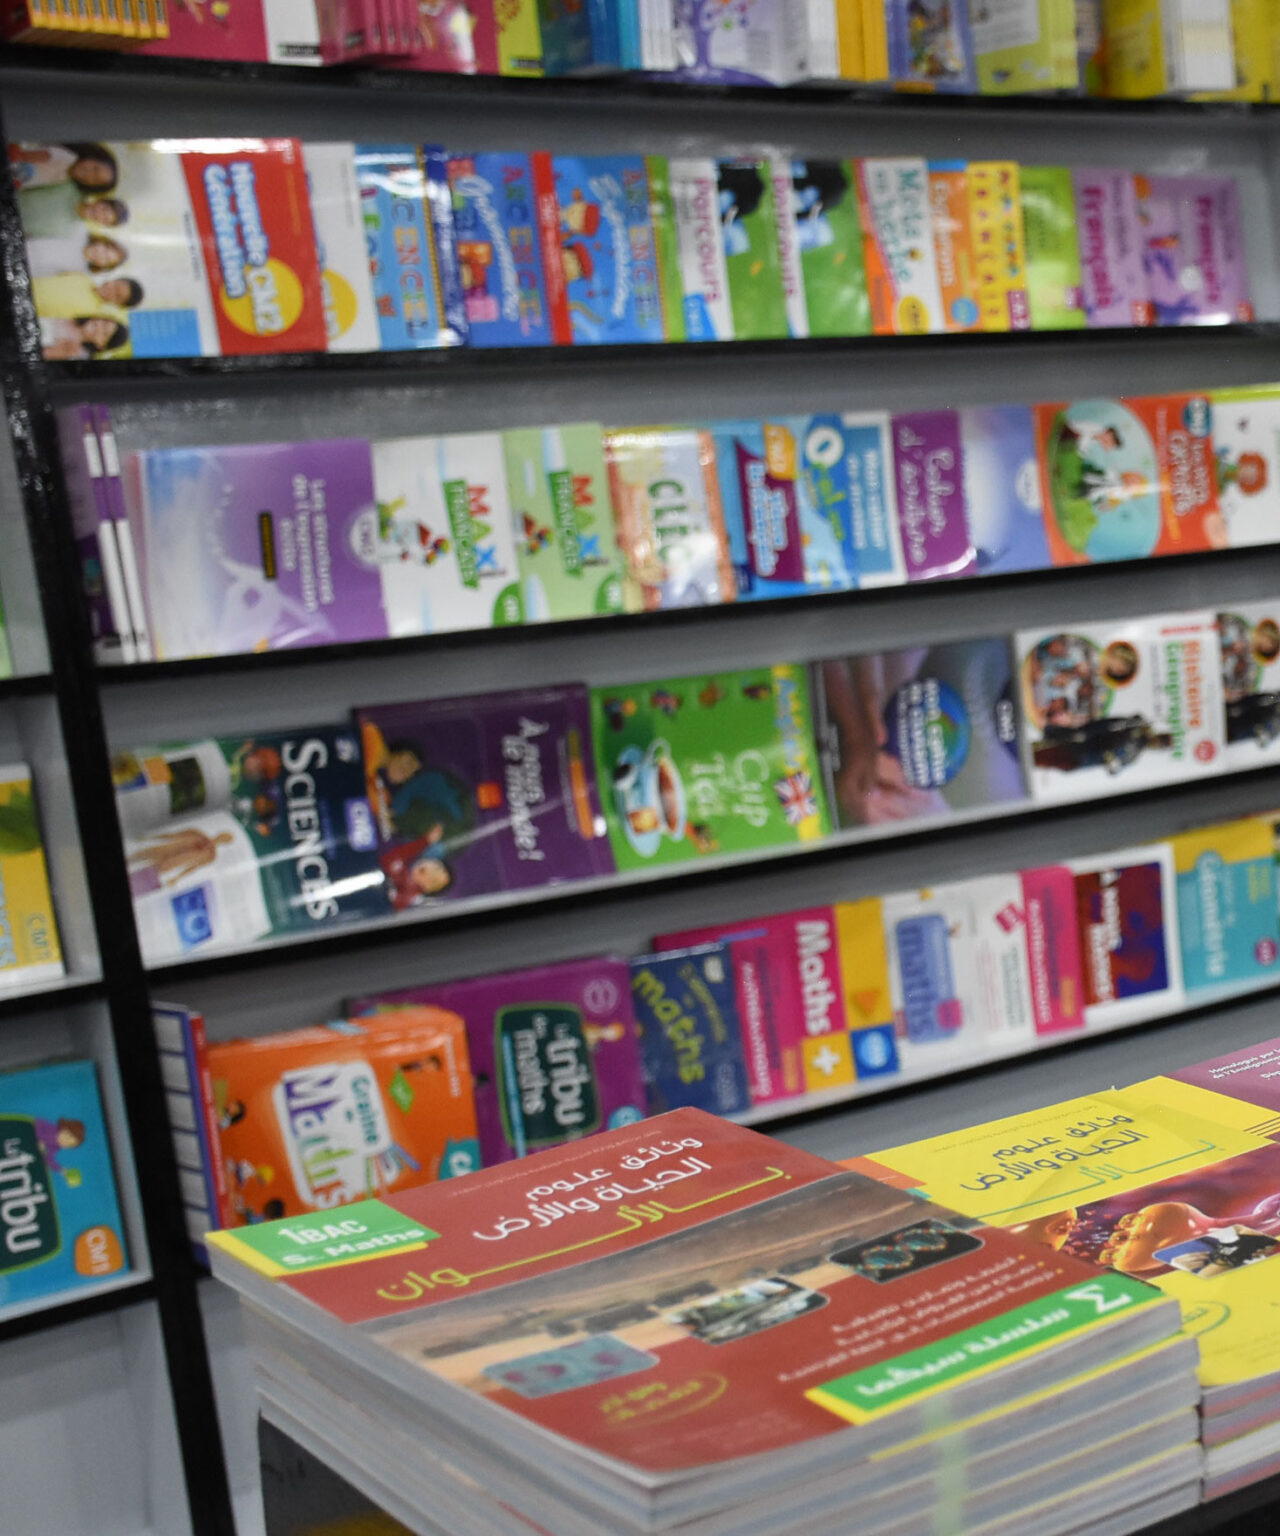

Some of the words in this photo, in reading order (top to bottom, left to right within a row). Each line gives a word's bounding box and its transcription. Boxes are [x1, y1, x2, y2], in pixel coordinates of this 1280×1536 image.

[726, 746, 777, 830] Cup
[275, 735, 356, 923] SCIENCES
[787, 917, 847, 1037] Maths
[511, 1026, 552, 1116] maths
[541, 1034, 596, 1129] tribu
[348, 1074, 382, 1148] Graine
[1066, 1113, 1135, 1139] وثائق
[595, 1156, 713, 1201] الحياة
[619, 1136, 704, 1170] وثائق
[992, 1135, 1062, 1161] علوم
[0, 1150, 54, 1254] tribu
[524, 1167, 613, 1201] علوم
[473, 1195, 601, 1241] والأرض
[86, 1227, 112, 1276] CM1
